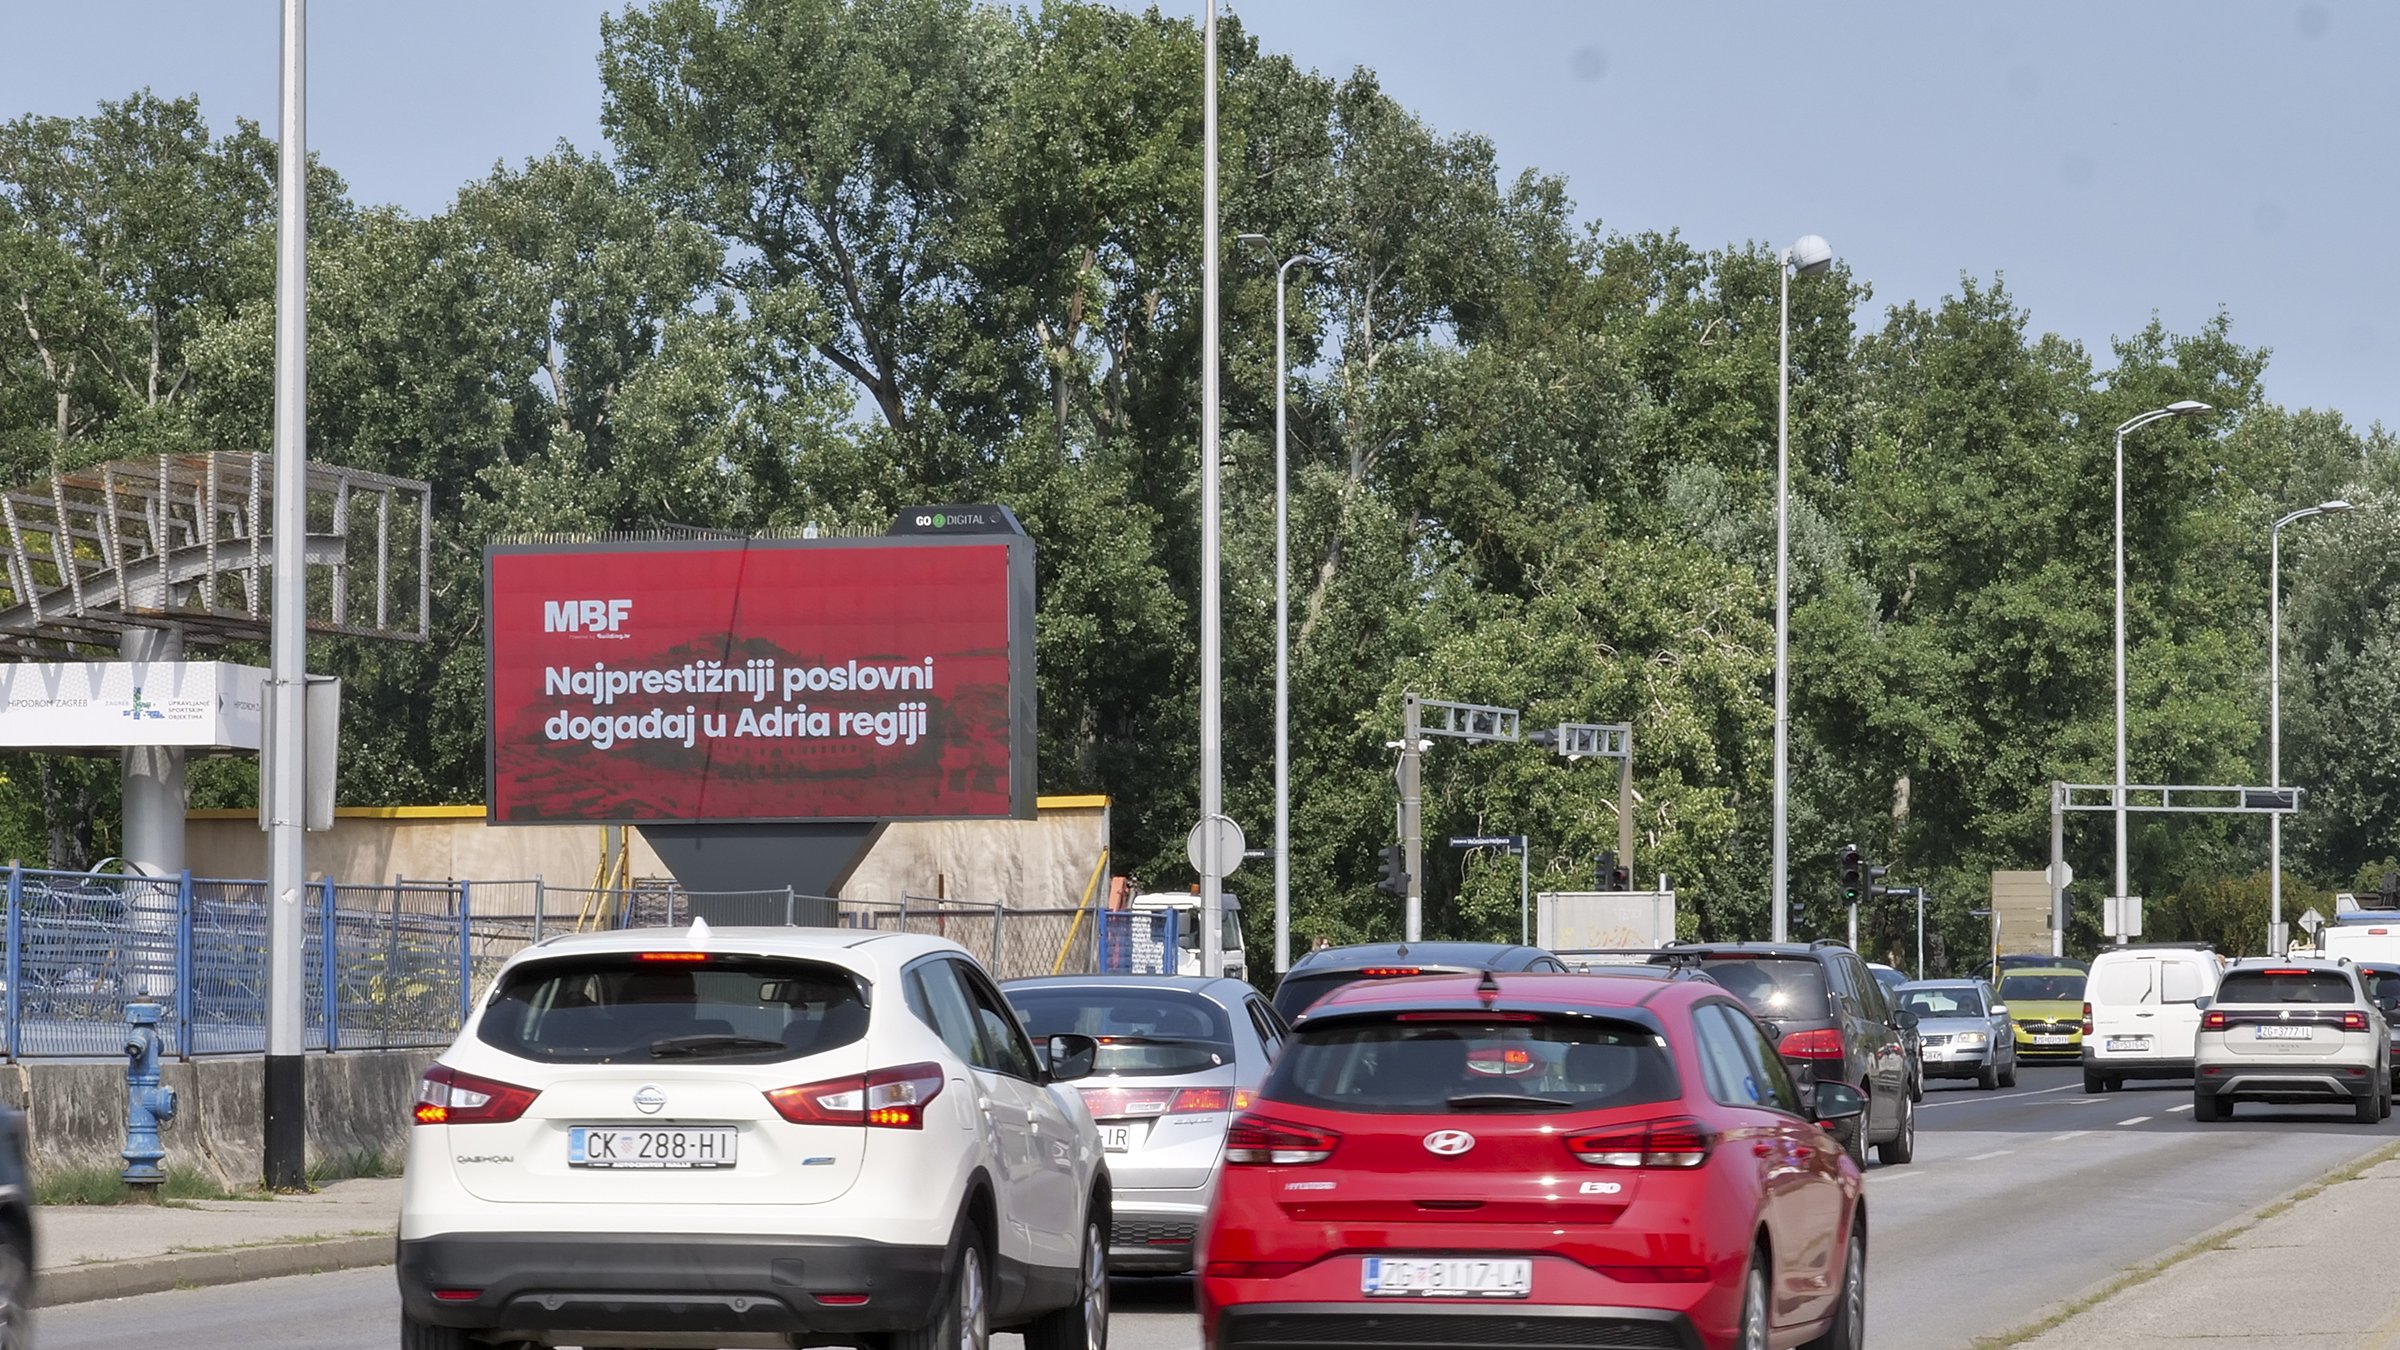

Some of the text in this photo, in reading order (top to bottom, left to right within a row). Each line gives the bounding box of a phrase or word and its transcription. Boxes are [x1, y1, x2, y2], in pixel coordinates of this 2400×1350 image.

[915, 515, 932, 526] GO
[946, 514, 985, 526] DIGITAL
[544, 599, 633, 632] MBF
[545, 656, 934, 705] Najprestižniji poslovni
[55, 699, 88, 708] ZAGREB
[544, 701, 927, 750] događaj u Adria regiji
[638, 1132, 727, 1159] 288-HI
